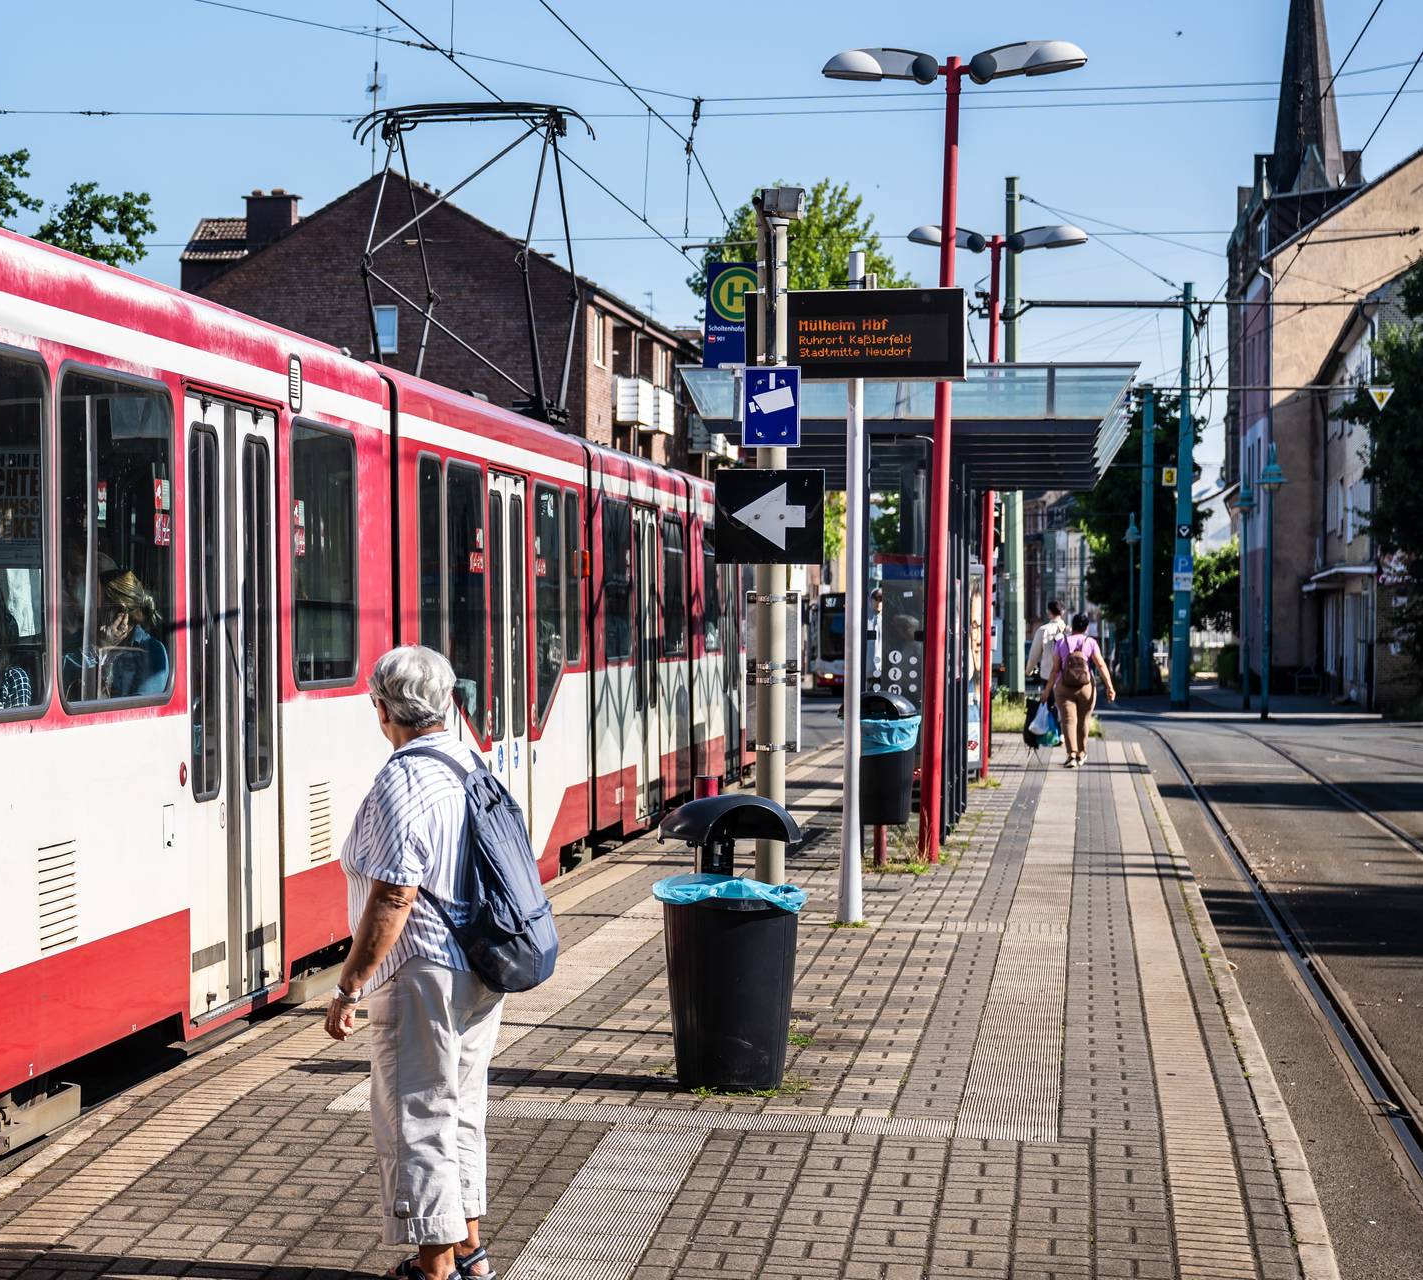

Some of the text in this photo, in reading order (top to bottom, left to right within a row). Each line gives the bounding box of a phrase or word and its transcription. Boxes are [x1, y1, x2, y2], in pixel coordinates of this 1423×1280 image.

[798, 318, 889, 332] Mülheim Hbf
[798, 334, 912, 346] Ruhrort Kaßlerfeld
[799, 346, 913, 358] Stadtmitte Neudorf
[1178, 558, 1189, 573] P
